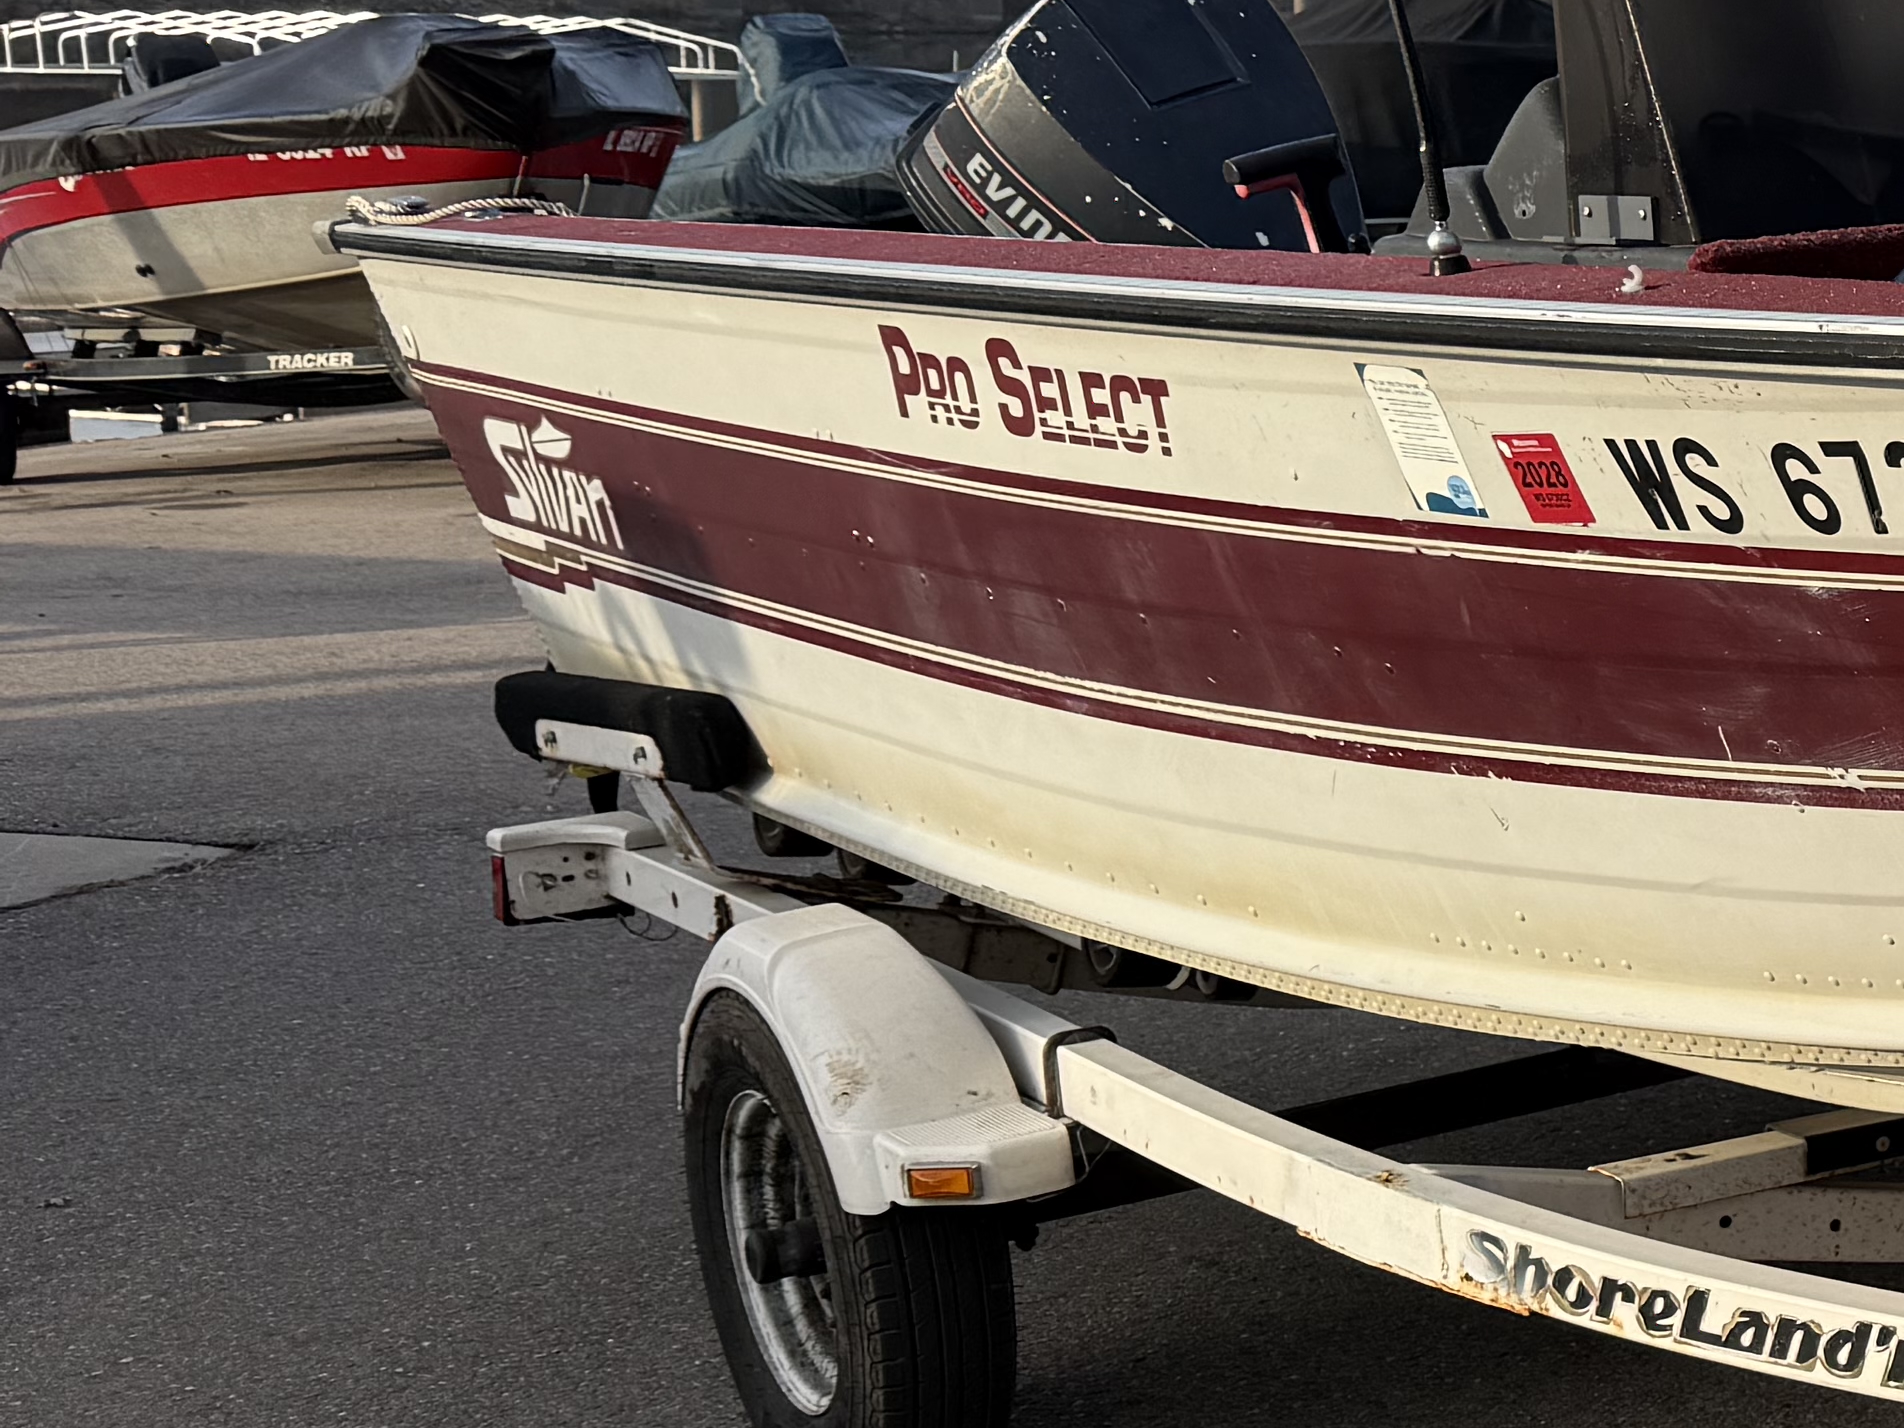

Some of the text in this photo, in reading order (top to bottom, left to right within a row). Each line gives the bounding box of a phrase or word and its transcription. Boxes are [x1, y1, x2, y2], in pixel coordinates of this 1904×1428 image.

[966, 152, 1074, 242] EVIN
[266, 352, 354, 371] TRACKER
[1512, 460, 1569, 489] 2028
[1603, 437, 1744, 536] WS
